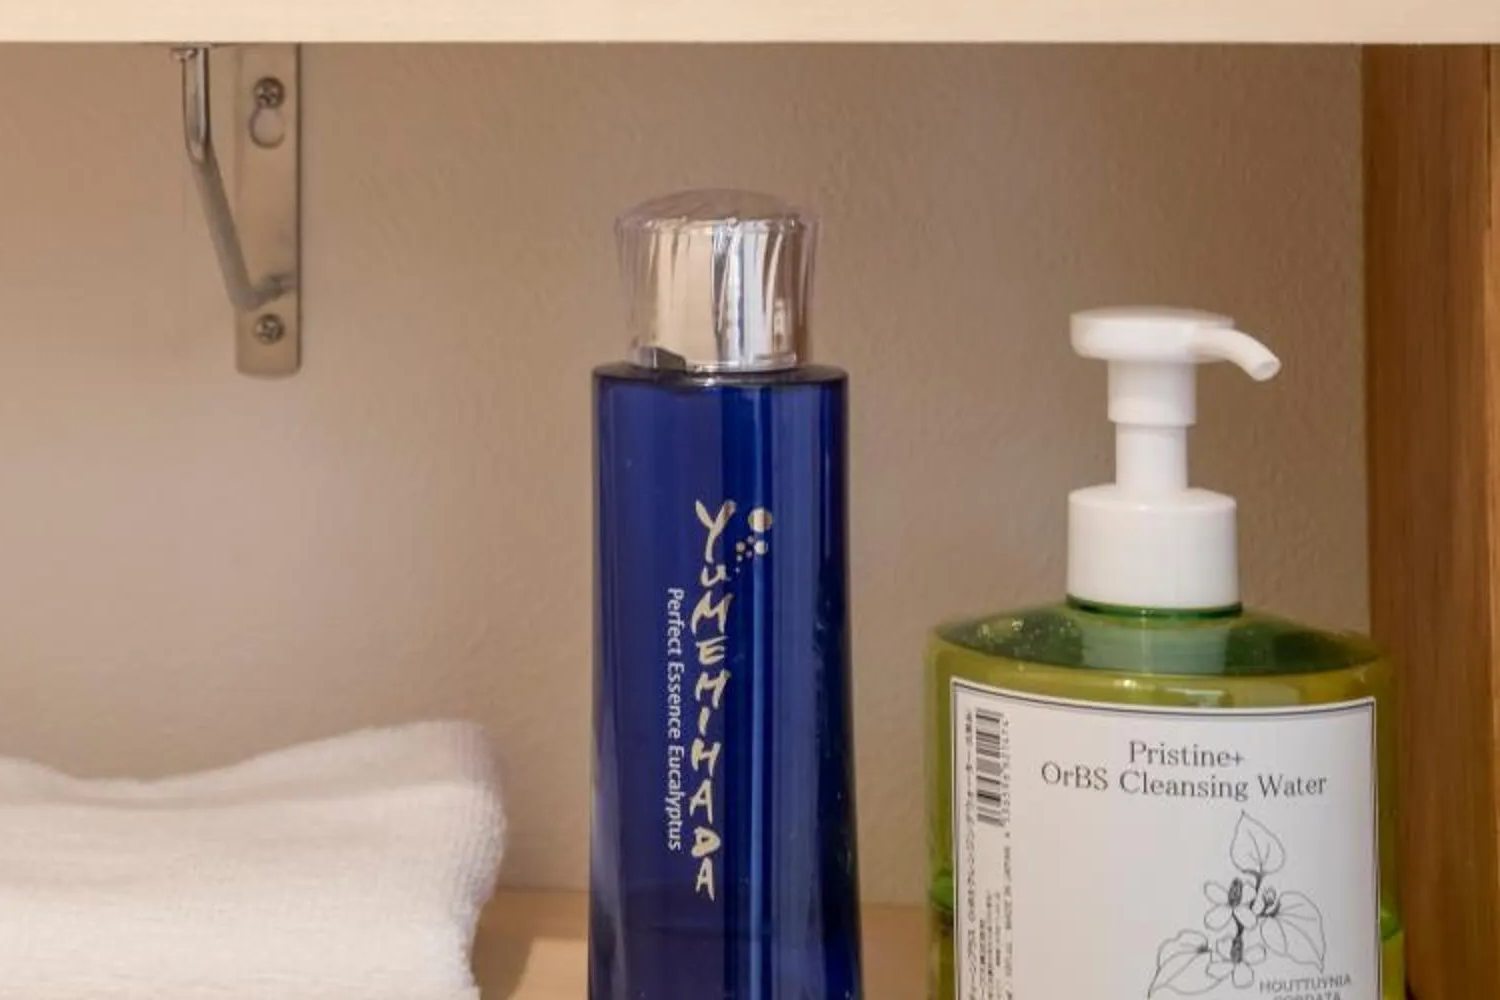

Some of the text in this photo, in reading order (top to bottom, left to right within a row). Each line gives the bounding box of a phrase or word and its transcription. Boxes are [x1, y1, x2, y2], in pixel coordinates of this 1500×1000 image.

[664, 587, 685, 852] Perfect Essence Eucalyptus
[1129, 740, 1245, 768] Pristine+
[1041, 760, 1328, 802] OrBS Cleansing Water
[1259, 974, 1351, 993] HOUTTUYNIA
